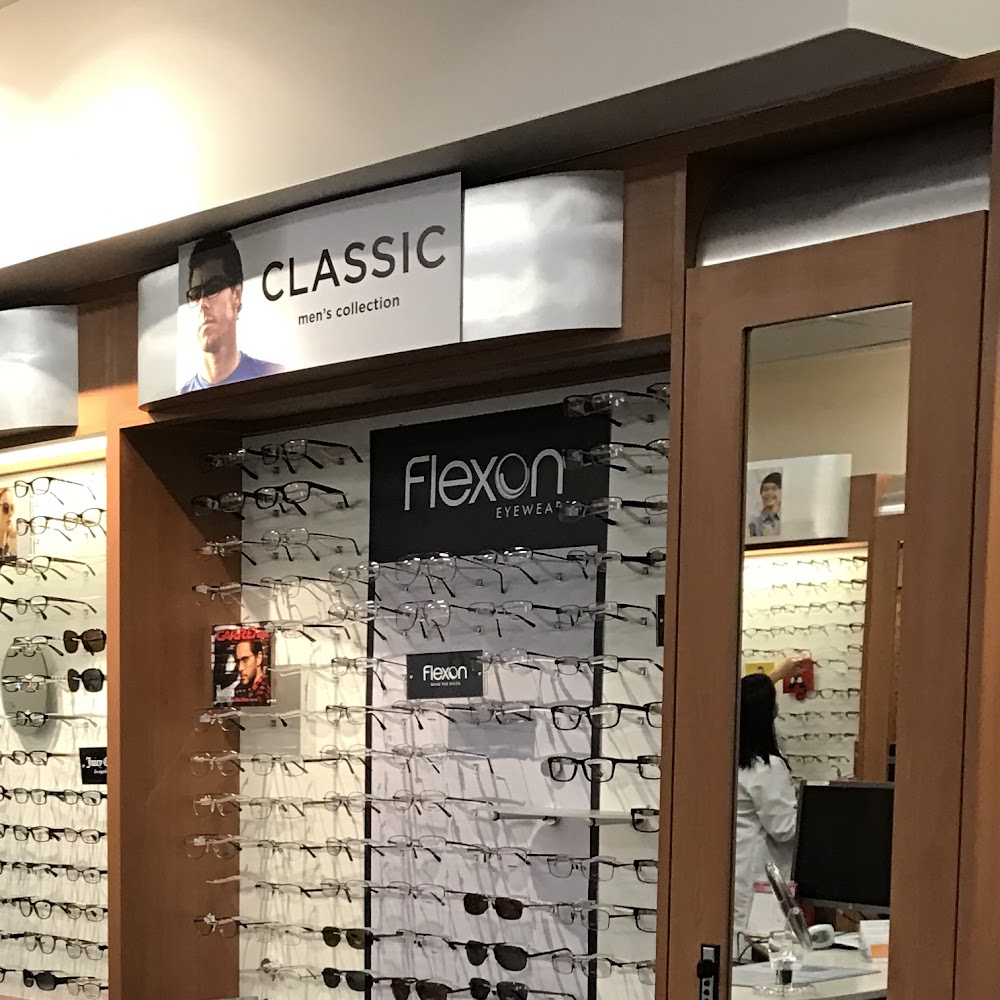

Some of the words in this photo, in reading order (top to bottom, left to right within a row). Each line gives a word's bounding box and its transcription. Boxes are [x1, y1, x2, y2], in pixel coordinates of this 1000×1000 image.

[262, 225, 446, 301] CLASSIC
[298, 308, 332, 325] men's
[336, 296, 400, 317] collection
[404, 449, 564, 511] Flexon
[423, 665, 468, 681] Flexon
